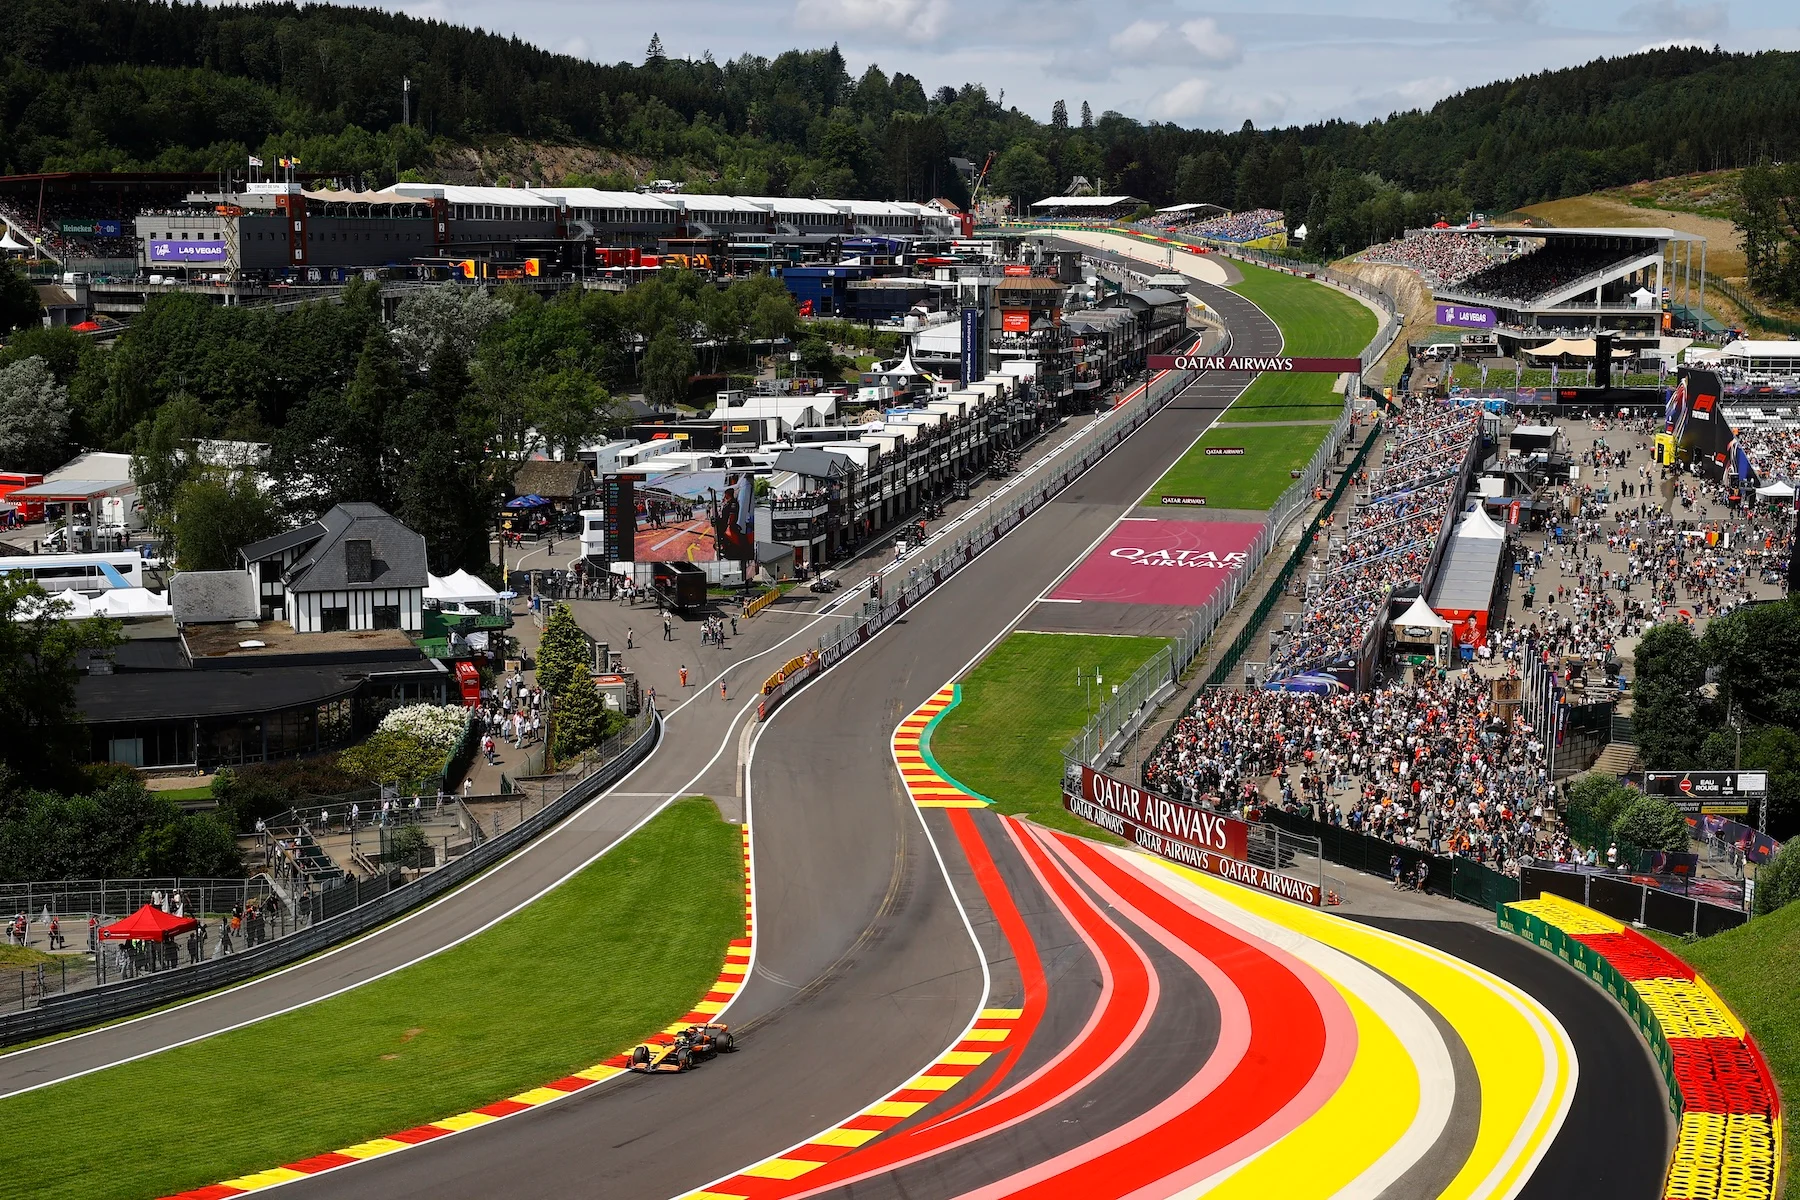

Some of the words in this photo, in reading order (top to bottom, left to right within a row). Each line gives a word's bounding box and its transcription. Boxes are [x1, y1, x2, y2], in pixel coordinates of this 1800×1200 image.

[63, 224, 92, 232] Heineken
[1459, 312, 1470, 321] LAS
[1470, 314, 1486, 323] VEGAS
[1174, 356, 1225, 370] QATAR
[1229, 357, 1293, 370] AIRWAYS
[1109, 547, 1250, 562] QATAR
[1131, 558, 1246, 570] AIRWAYS
[904, 586, 918, 606] QATAR
[866, 614, 881, 636] QATAR
[881, 601, 900, 624] AIRWAYS
[822, 643, 840, 668] QATAR
[840, 630, 860, 656] AIRWAYS
[1070, 797, 1093, 821] QATAR
[1094, 809, 1124, 835] AIRWAYS
[1093, 774, 1141, 821] QATAR
[1145, 795, 1226, 850] AIRWAYS
[1135, 828, 1162, 853] QATAR
[1164, 842, 1209, 869] AIRWAYS
[1220, 858, 1258, 885] QATAR
[1261, 872, 1313, 903] AIRWAYS
[1500, 920, 1514, 932] ROLEX
[1522, 928, 1534, 941] ROLEX
